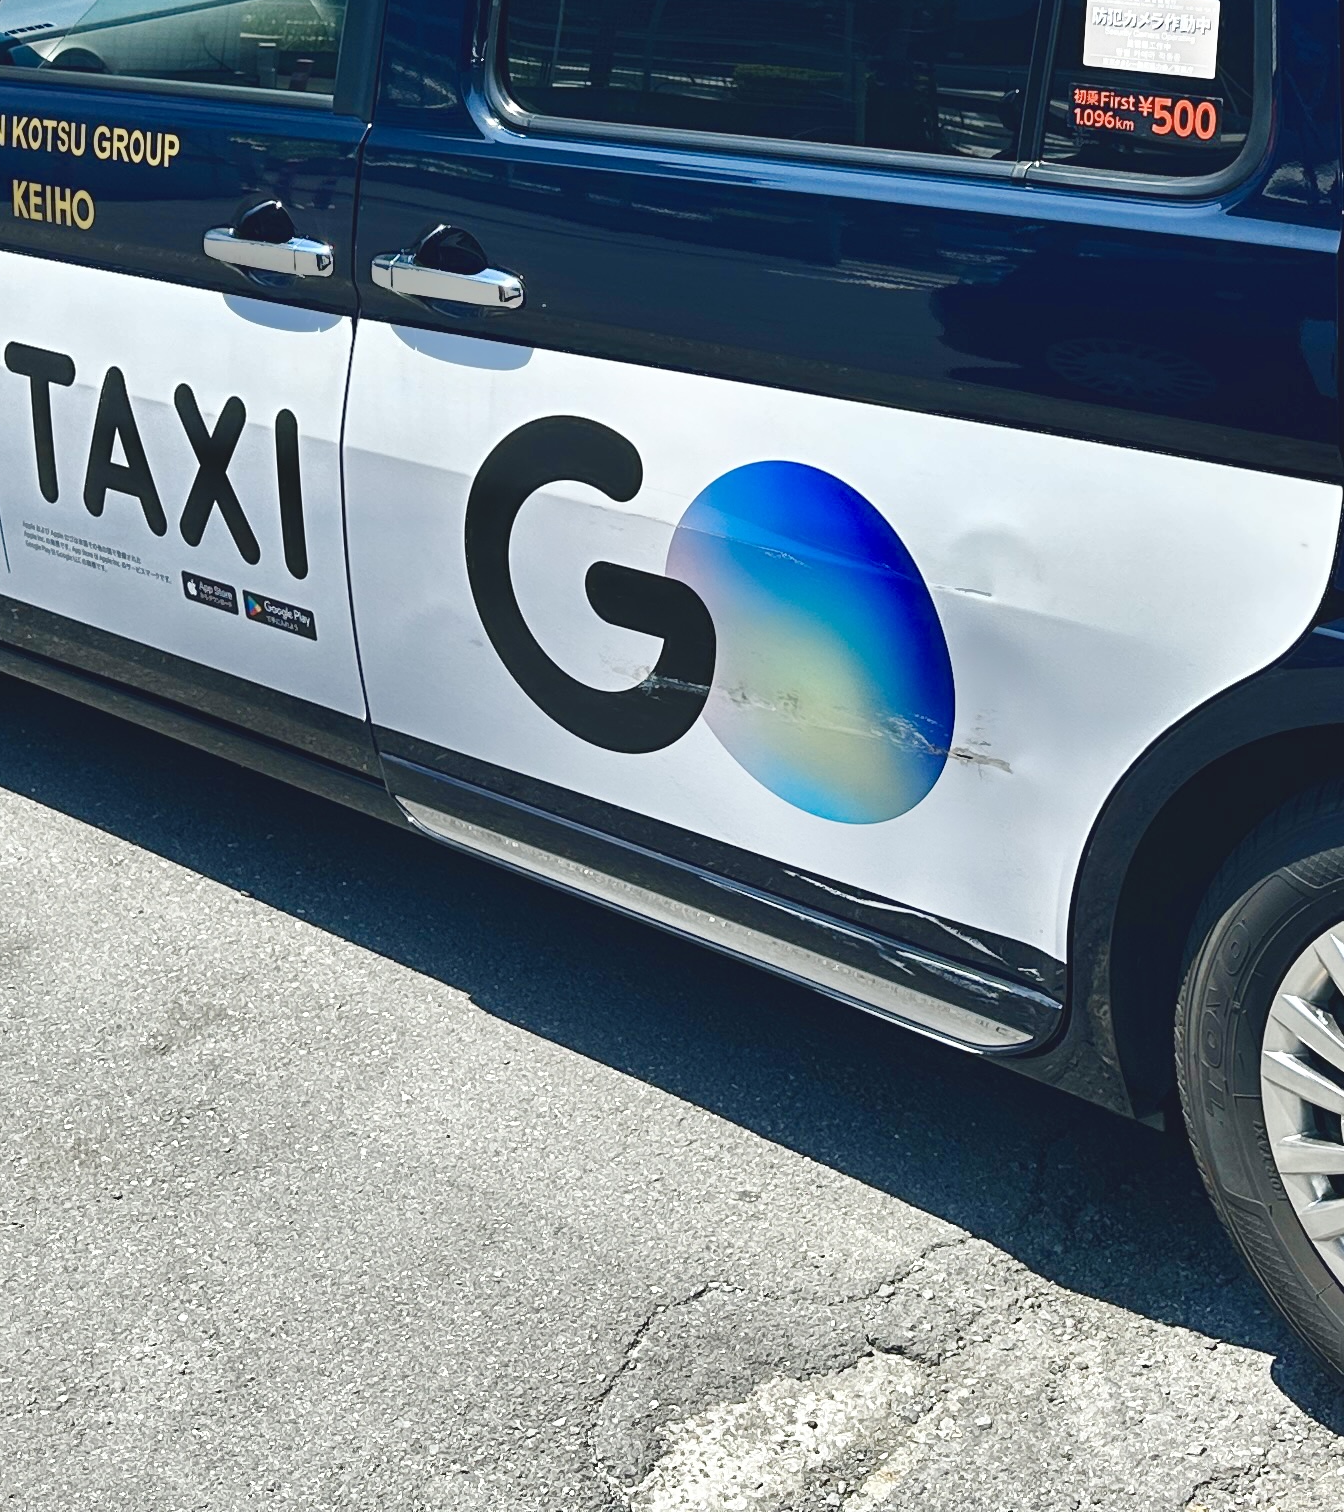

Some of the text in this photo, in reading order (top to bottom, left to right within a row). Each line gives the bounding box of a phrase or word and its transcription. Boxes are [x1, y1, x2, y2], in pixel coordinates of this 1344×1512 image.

[1091, 6, 1212, 35] 防犯カメラ作動中
[1100, 91, 1136, 111] First
[1138, 95, 1217, 140] ¥500
[12, 116, 86, 157] KOTSU
[93, 125, 180, 168] GROUP
[12, 179, 95, 230] KEIHO
[4, 340, 309, 580] TAXI
[263, 600, 311, 628] Google Play
